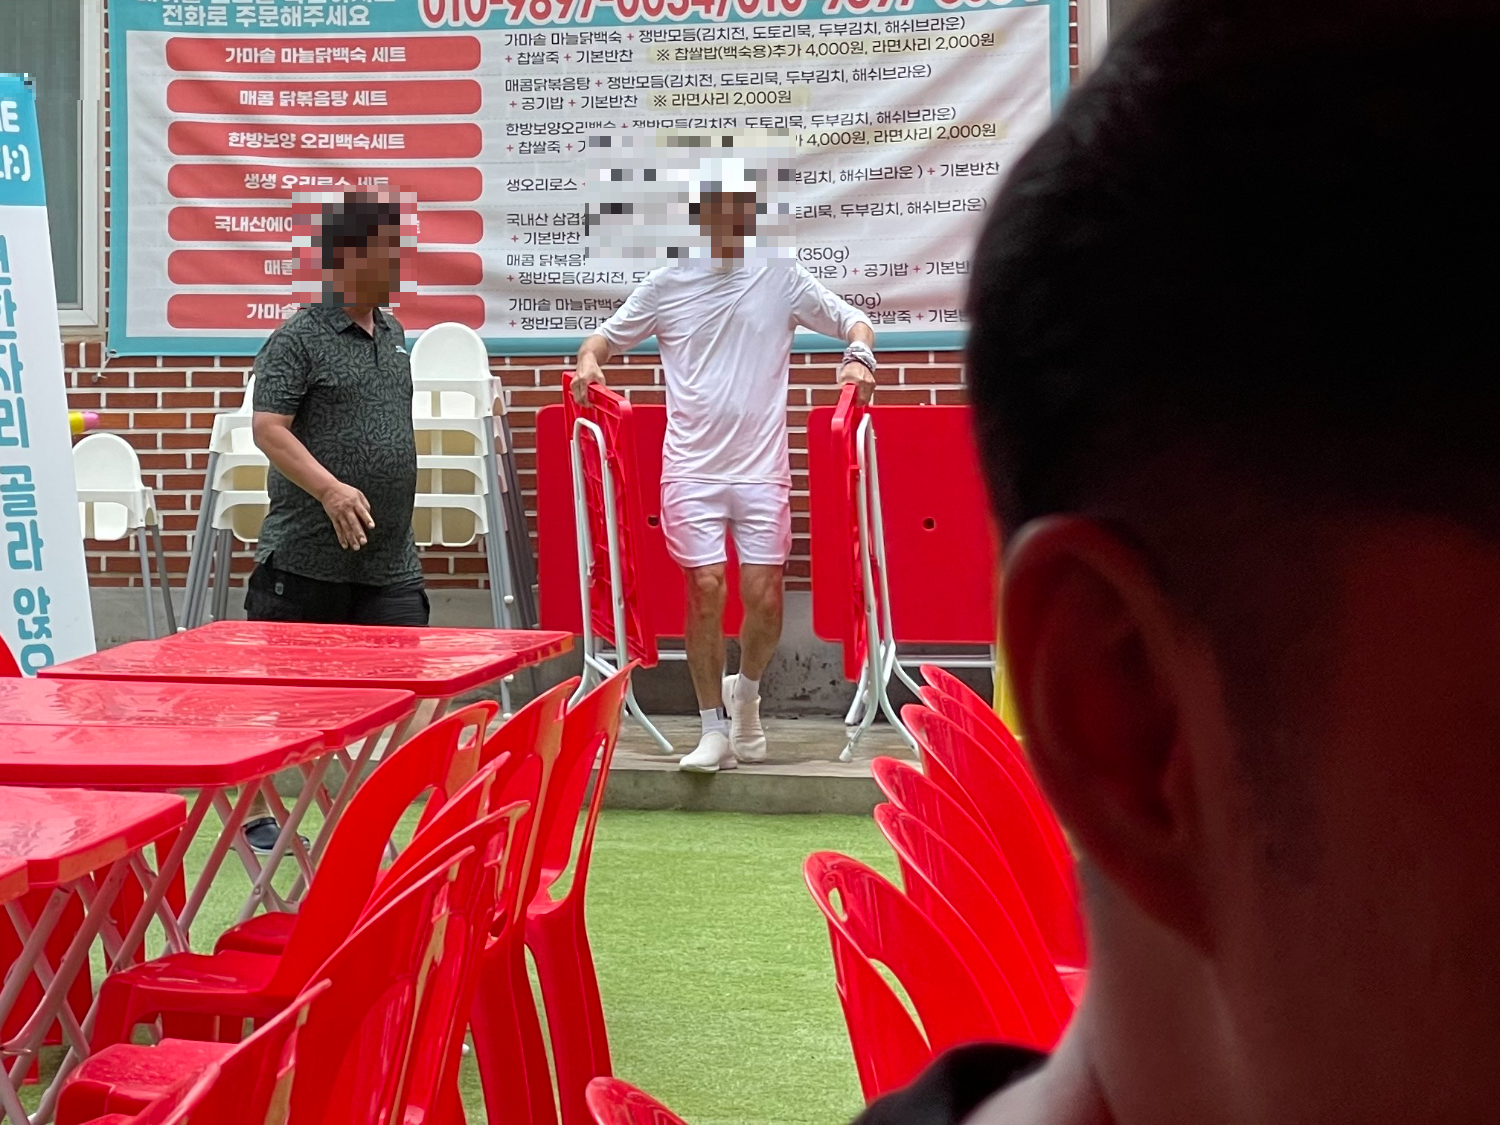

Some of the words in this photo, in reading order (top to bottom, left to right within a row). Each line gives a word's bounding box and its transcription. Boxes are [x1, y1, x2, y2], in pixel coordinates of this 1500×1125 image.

[162, 4, 228, 27] 전화로
[235, 4, 371, 28] 주문해주세요
[504, 33, 546, 47] 가마솥
[551, 30, 622, 46] 마늘닭백숙
[752, 24, 815, 39] 도토리묵,
[818, 21, 882, 38] 두부김치,
[885, 15, 966, 34] 해쉬브라운)
[225, 47, 276, 64] 가마솥
[281, 46, 367, 64] 마늘닭백숙
[371, 46, 407, 63] 세트
[675, 43, 802, 61] 찹쌀밥(백숙용)추가
[805, 41, 868, 57] 4,000원,
[872, 37, 931, 53] 라면사리
[935, 32, 995, 51] 2,000원
[517, 51, 559, 66] 찹쌀죽
[576, 49, 634, 64] 기본반찬
[505, 77, 590, 92] 매콤닭볶음탕
[720, 71, 782, 87] 도토리묵,
[786, 69, 849, 85] 두부김치,
[852, 64, 932, 82] 해쉬브라운)
[239, 90, 275, 107] 매콤
[279, 90, 349, 107] 닭볶음탕
[352, 90, 388, 107] 세트
[521, 96, 564, 111] 공기밥
[581, 94, 638, 109] 기본반찬
[672, 92, 729, 107] 라면사리
[733, 90, 792, 105] 2,000원
[811, 111, 873, 128] 두부김치,
[876, 106, 956, 124] 해쉬브라운)
[228, 131, 297, 149] 한방보양
[300, 133, 406, 150] 오리백숙세트
[806, 130, 870, 146] 4,000원,
[873, 127, 932, 143] 라면사리
[936, 123, 996, 140] 2,000원
[518, 140, 561, 155] 찹쌀죽
[940, 161, 1000, 177] 기본반찬
[244, 173, 277, 190] 생생
[506, 178, 578, 192] 생오리로스
[840, 201, 904, 219] 두부김치,
[906, 197, 988, 216] 해쉬브라운)
[215, 216, 292, 232] 국내산에
[506, 213, 549, 227] 국내산
[523, 231, 581, 245] 기본반찬
[506, 254, 535, 267] 매콤
[539, 253, 585, 267] 닭볶음
[864, 262, 909, 278] 공기밥
[925, 261, 971, 275] 기본반
[508, 298, 551, 312] 가마솥
